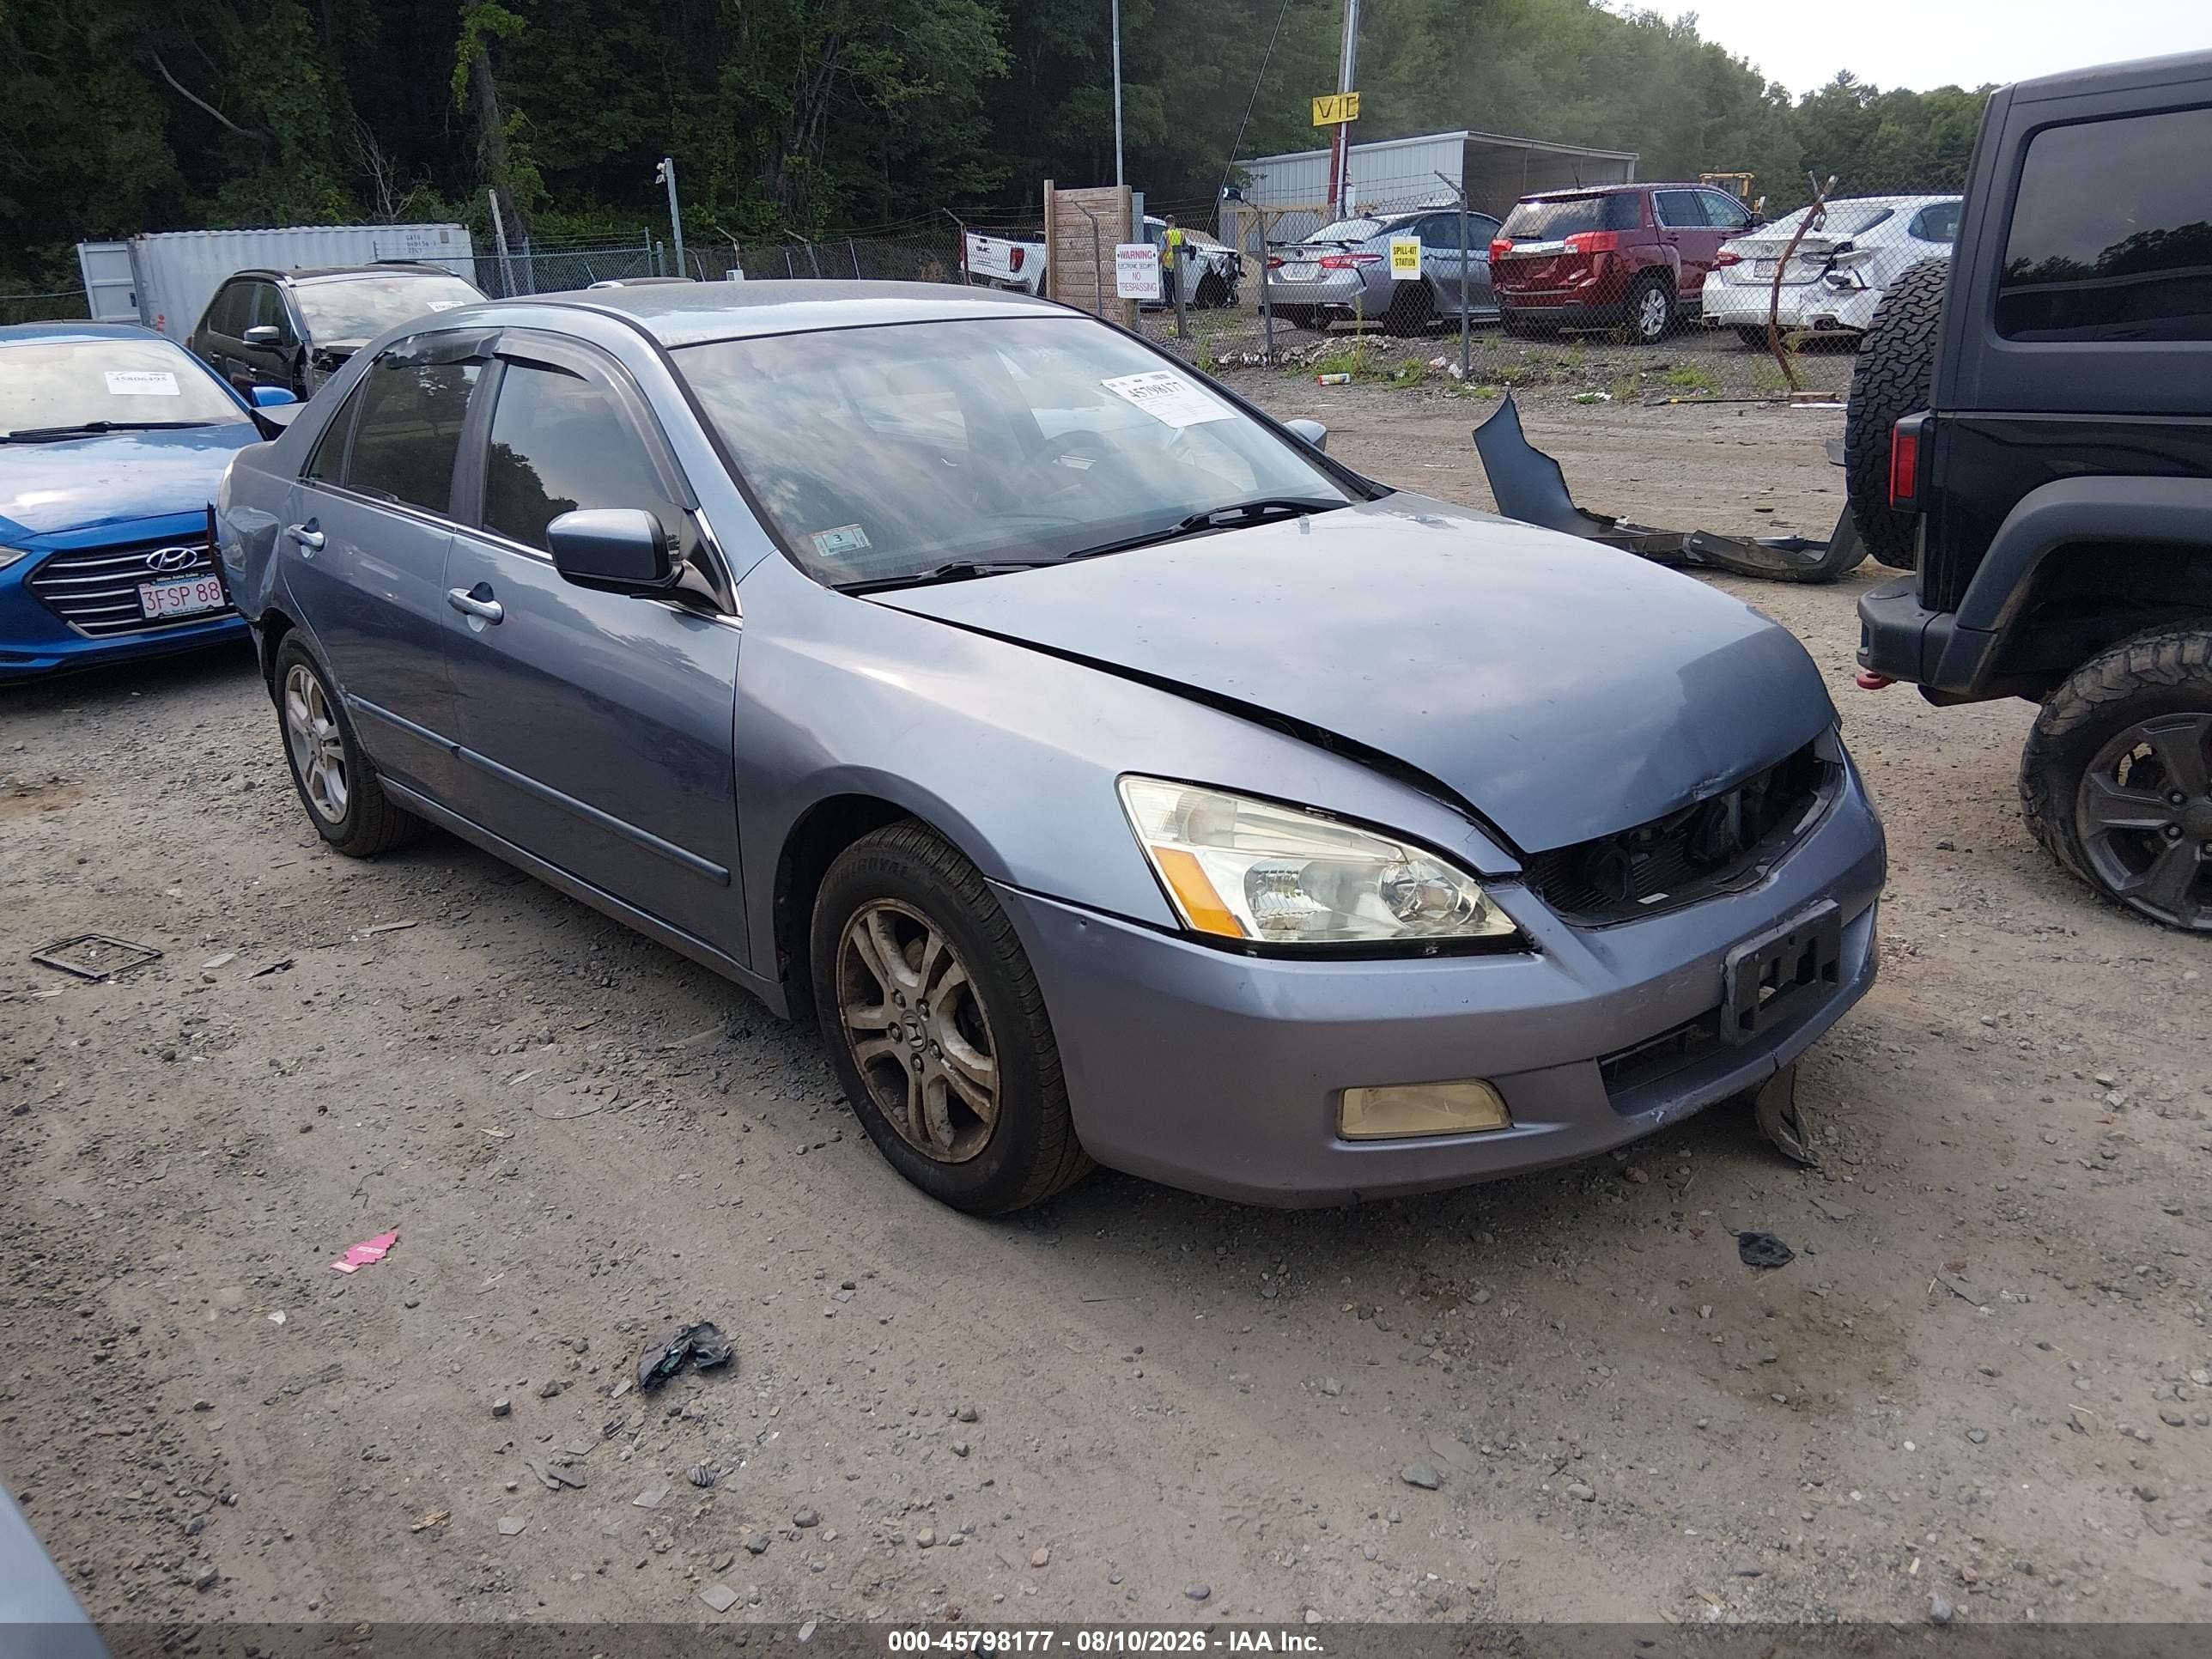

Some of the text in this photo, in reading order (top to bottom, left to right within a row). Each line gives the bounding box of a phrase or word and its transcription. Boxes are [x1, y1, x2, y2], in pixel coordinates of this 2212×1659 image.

[1119, 250, 1153, 259] WARNING
[1393, 246, 1417, 255] SPILL-KIT
[1395, 258, 1416, 267] STATION
[1132, 271, 1141, 281] NO
[1118, 282, 1158, 292] TRESPASSING
[1127, 381, 1187, 398] 45798177
[833, 534, 842, 543] 3
